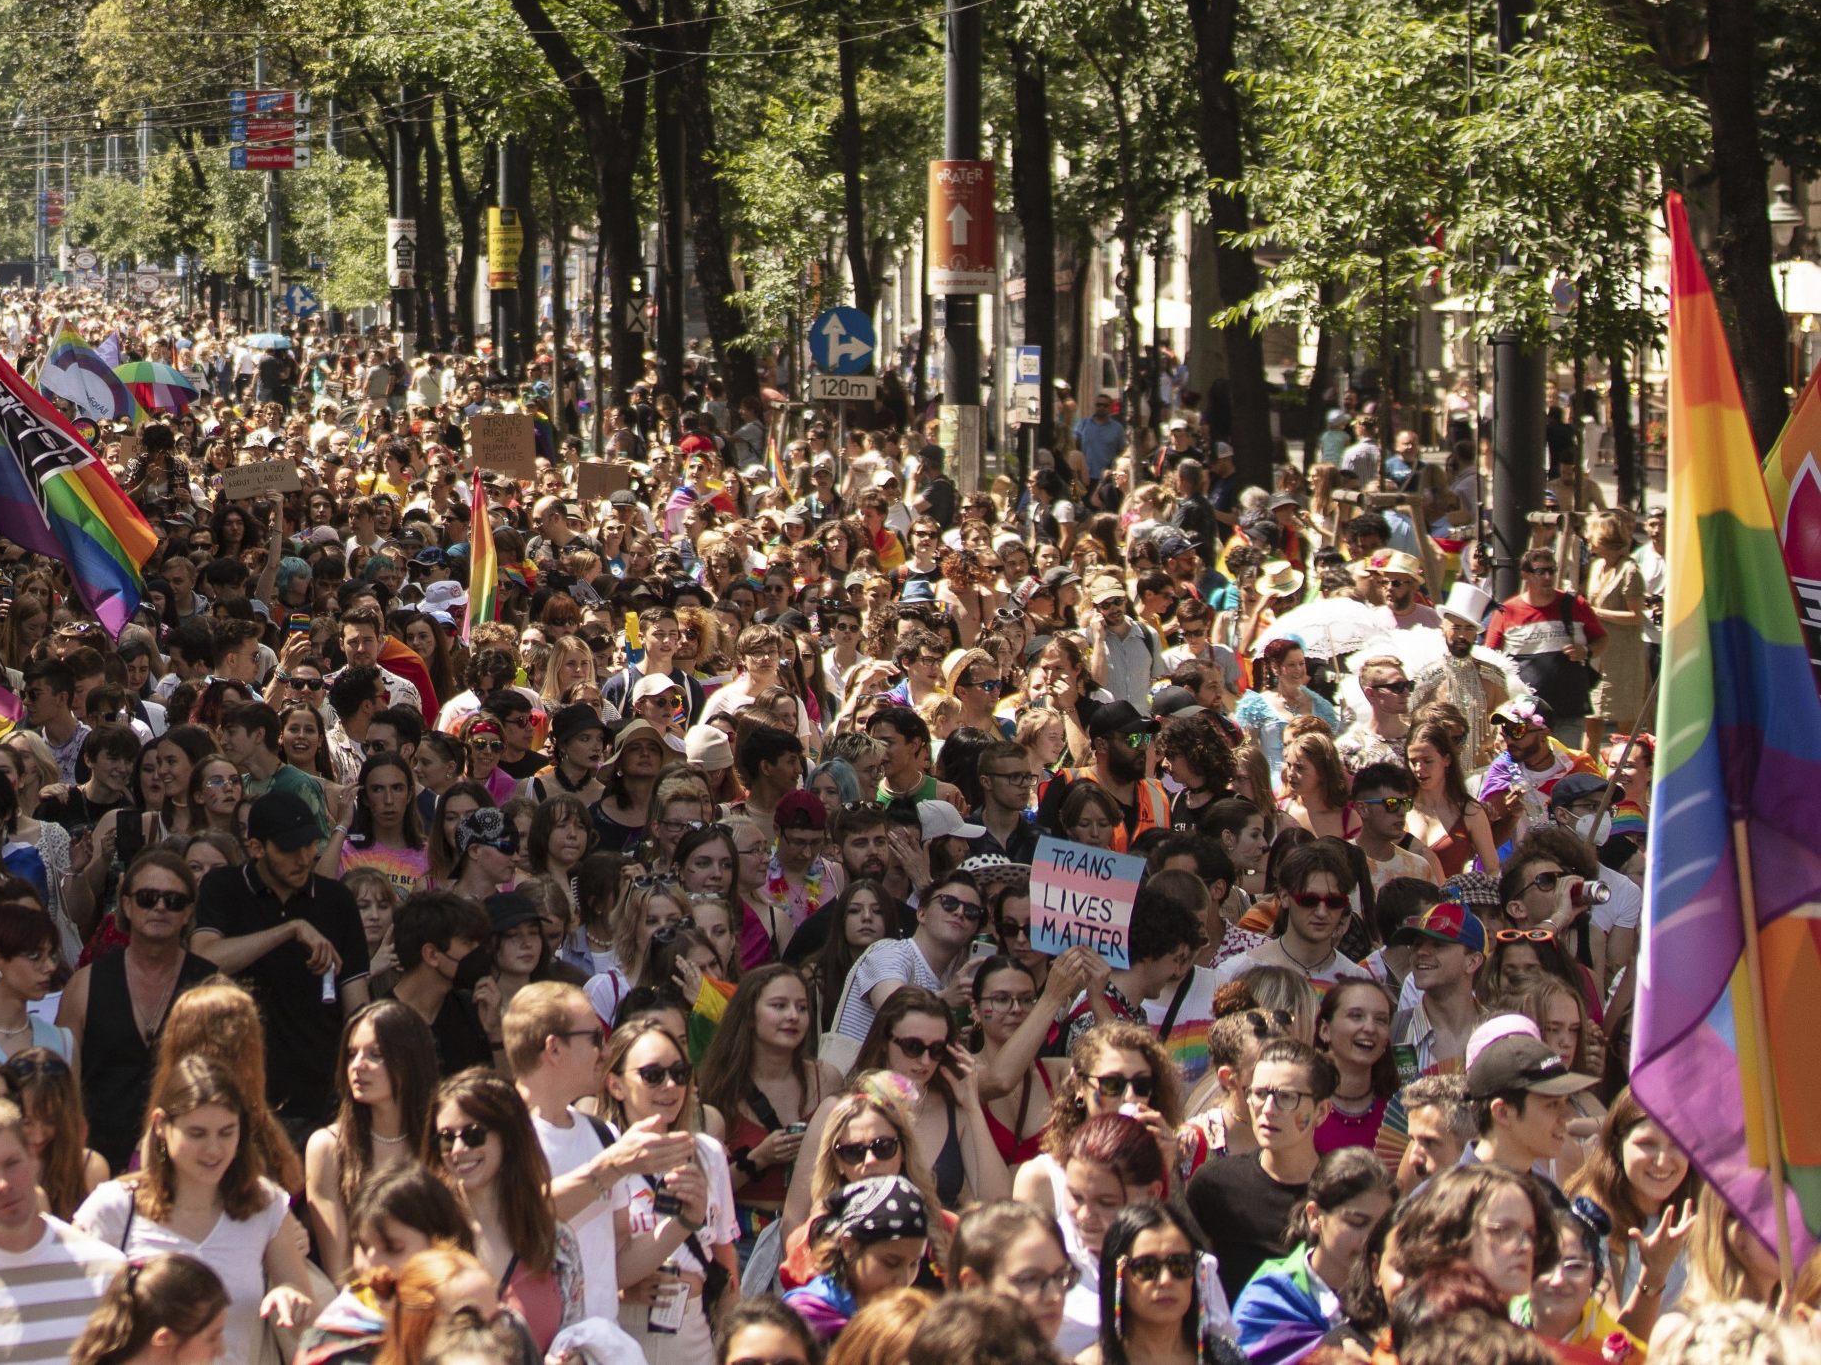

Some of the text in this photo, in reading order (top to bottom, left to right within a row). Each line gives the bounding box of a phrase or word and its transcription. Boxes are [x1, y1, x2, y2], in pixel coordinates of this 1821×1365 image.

[936, 168, 984, 185] PRATER
[820, 379, 868, 397] 120m
[483, 416, 523, 427] TRANS
[483, 427, 523, 438] RIGHTS
[482, 442, 517, 452] HUMAN
[484, 451, 524, 462] RIGHTS
[1052, 847, 1117, 881] TRANS
[1044, 882, 1113, 923] LIVES
[1041, 916, 1126, 961] MATTER
